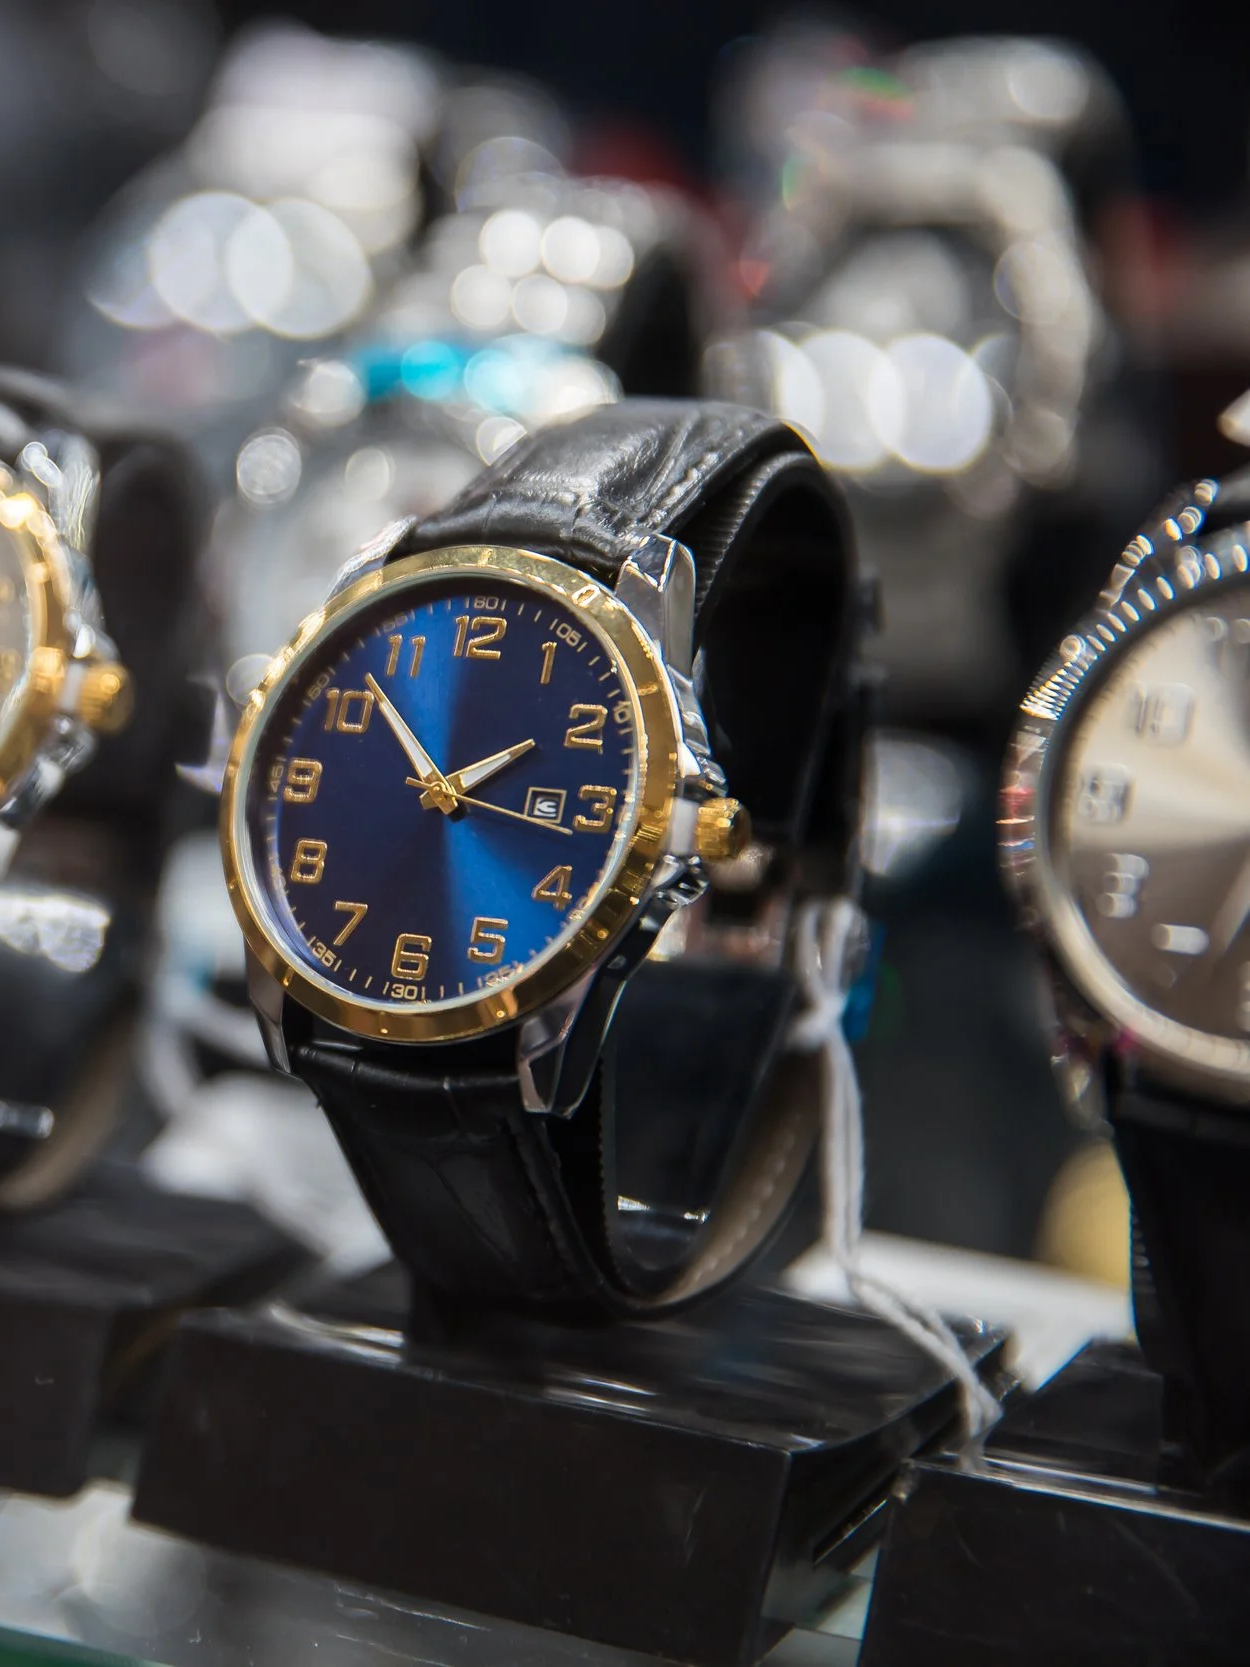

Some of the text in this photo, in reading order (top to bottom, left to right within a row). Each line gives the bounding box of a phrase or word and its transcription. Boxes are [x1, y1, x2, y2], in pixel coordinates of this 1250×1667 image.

[386, 634, 426, 678] 11
[454, 616, 507, 660] 12
[555, 623, 582, 648] 05
[540, 641, 558, 685] 1
[324, 687, 375, 734] 10
[564, 703, 609, 750] 2
[283, 757, 323, 803] 9
[573, 784, 618, 834] 3
[291, 838, 327, 884] 8
[531, 865, 573, 910] 4
[333, 900, 368, 946] 7
[467, 916, 509, 965] 5
[312, 941, 337, 967] 35
[391, 933, 432, 981] 6
[391, 984, 417, 1000] 30
